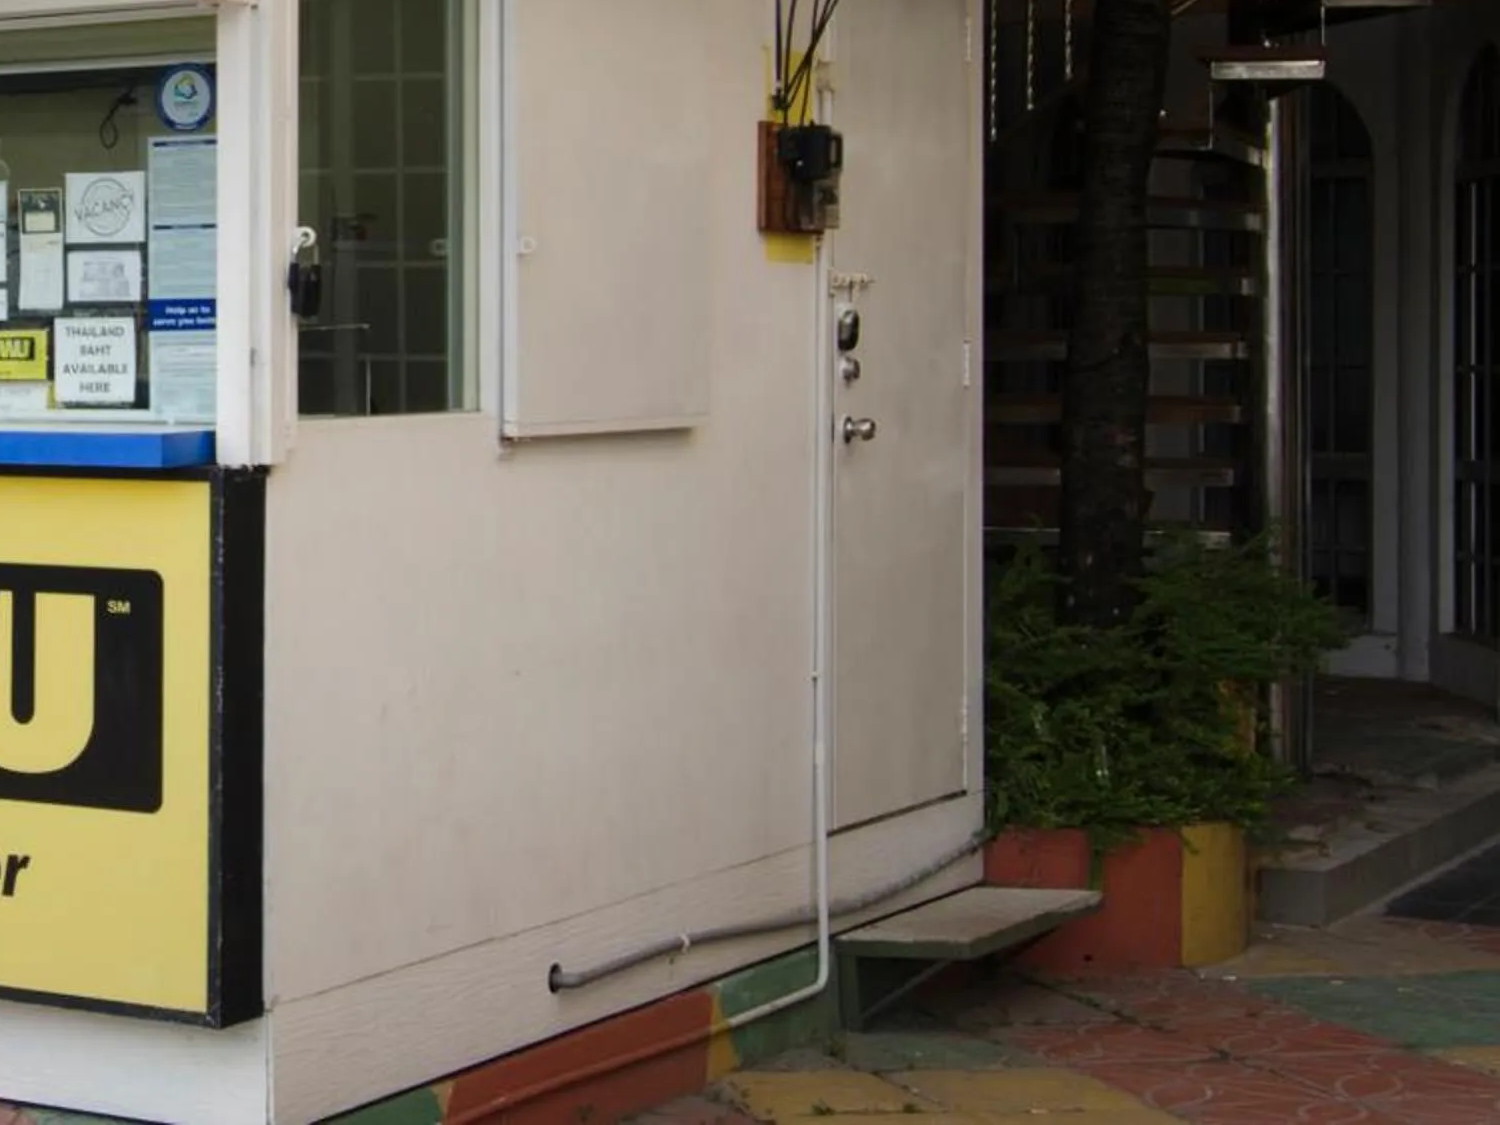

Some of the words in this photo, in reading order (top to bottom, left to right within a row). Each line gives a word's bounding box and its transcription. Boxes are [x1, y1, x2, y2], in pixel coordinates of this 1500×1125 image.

[65, 325, 126, 338] THAILAND
[62, 362, 129, 375] AVAILABLE
[79, 382, 111, 394] HERE
[106, 599, 131, 614] SM
